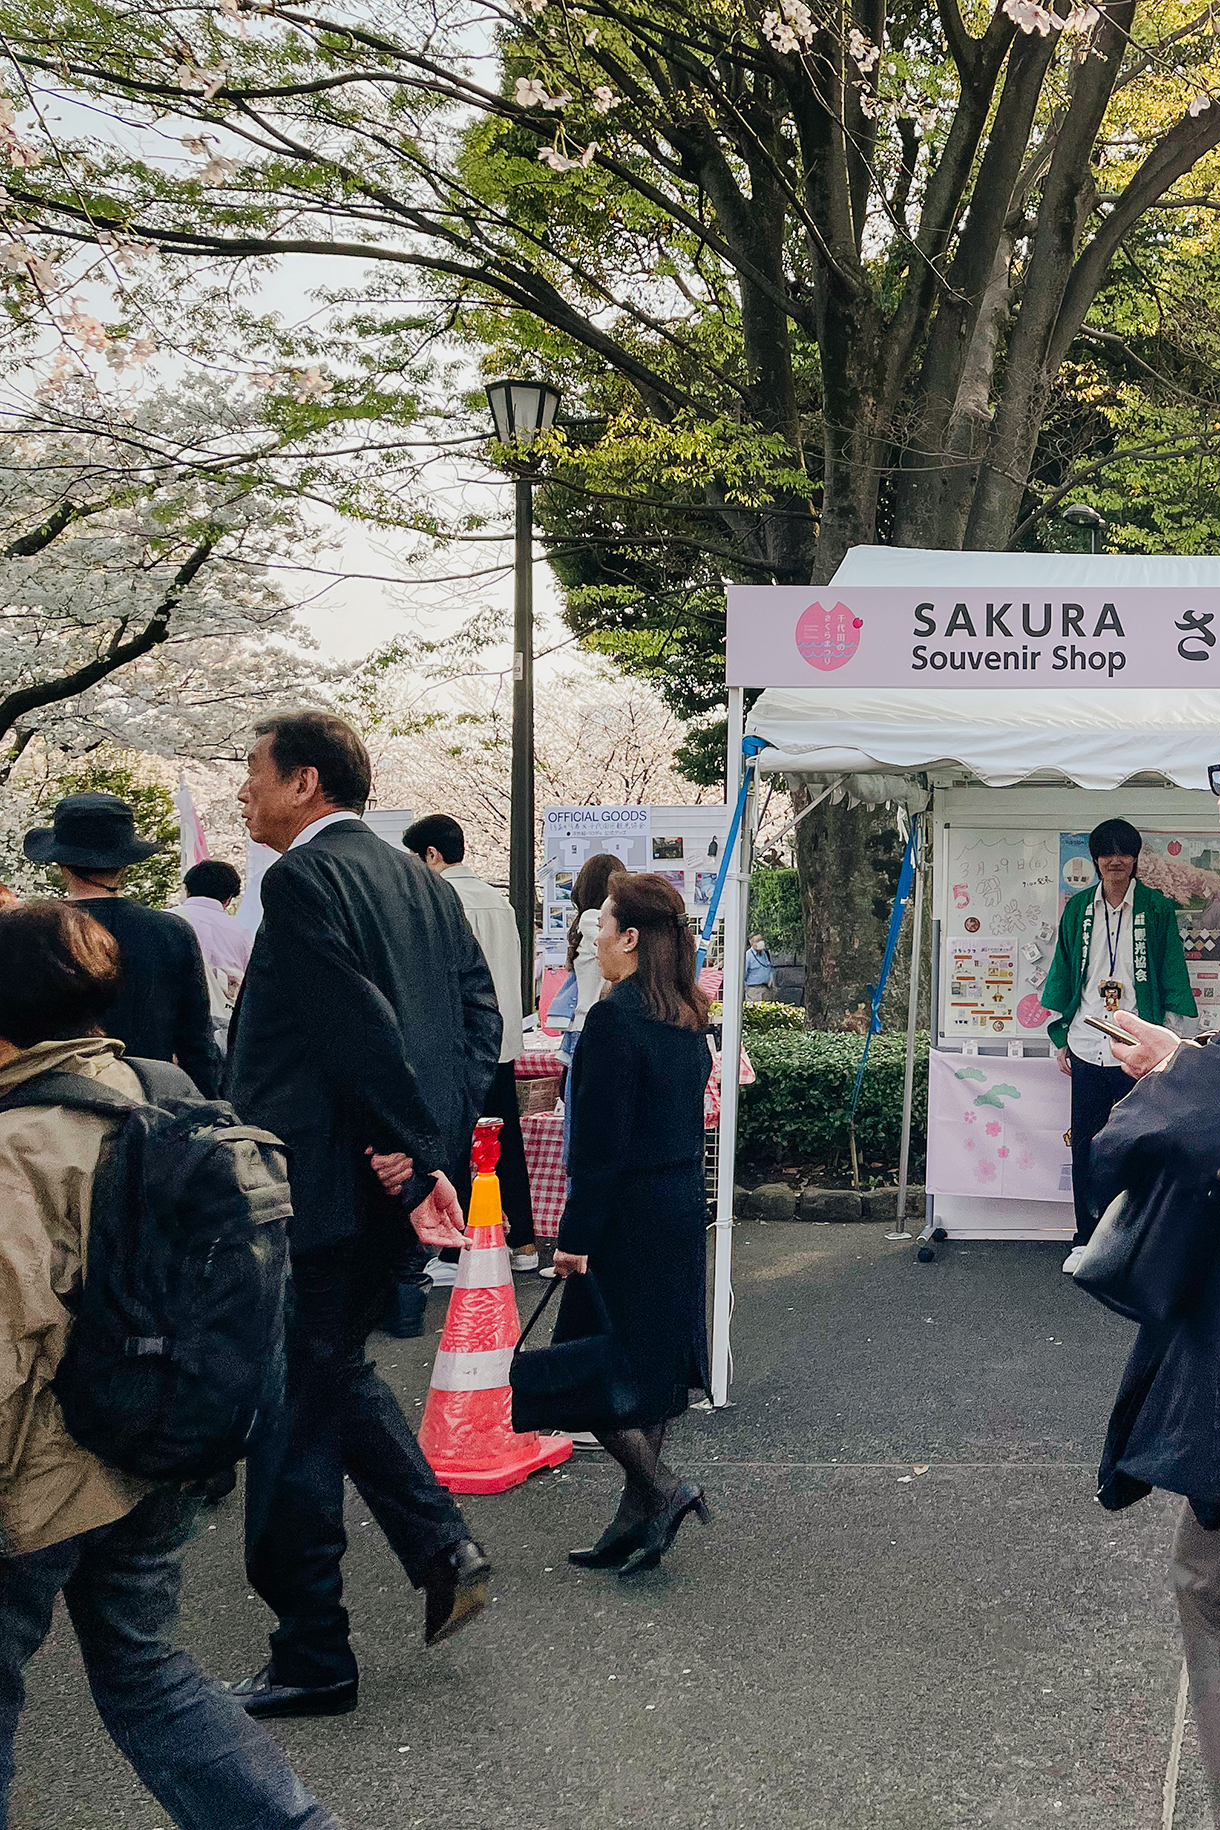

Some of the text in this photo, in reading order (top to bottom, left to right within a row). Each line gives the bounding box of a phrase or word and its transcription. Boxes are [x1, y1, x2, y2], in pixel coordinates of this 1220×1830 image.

[836, 613, 846, 652] 千代田の
[912, 602, 1126, 637] SAKURA
[823, 614, 832, 666] さくらまつり
[911, 645, 1127, 678] Souvenir Shop
[547, 810, 647, 823] OFFICIAL GOODS
[1133, 928, 1148, 983] 観光協会
